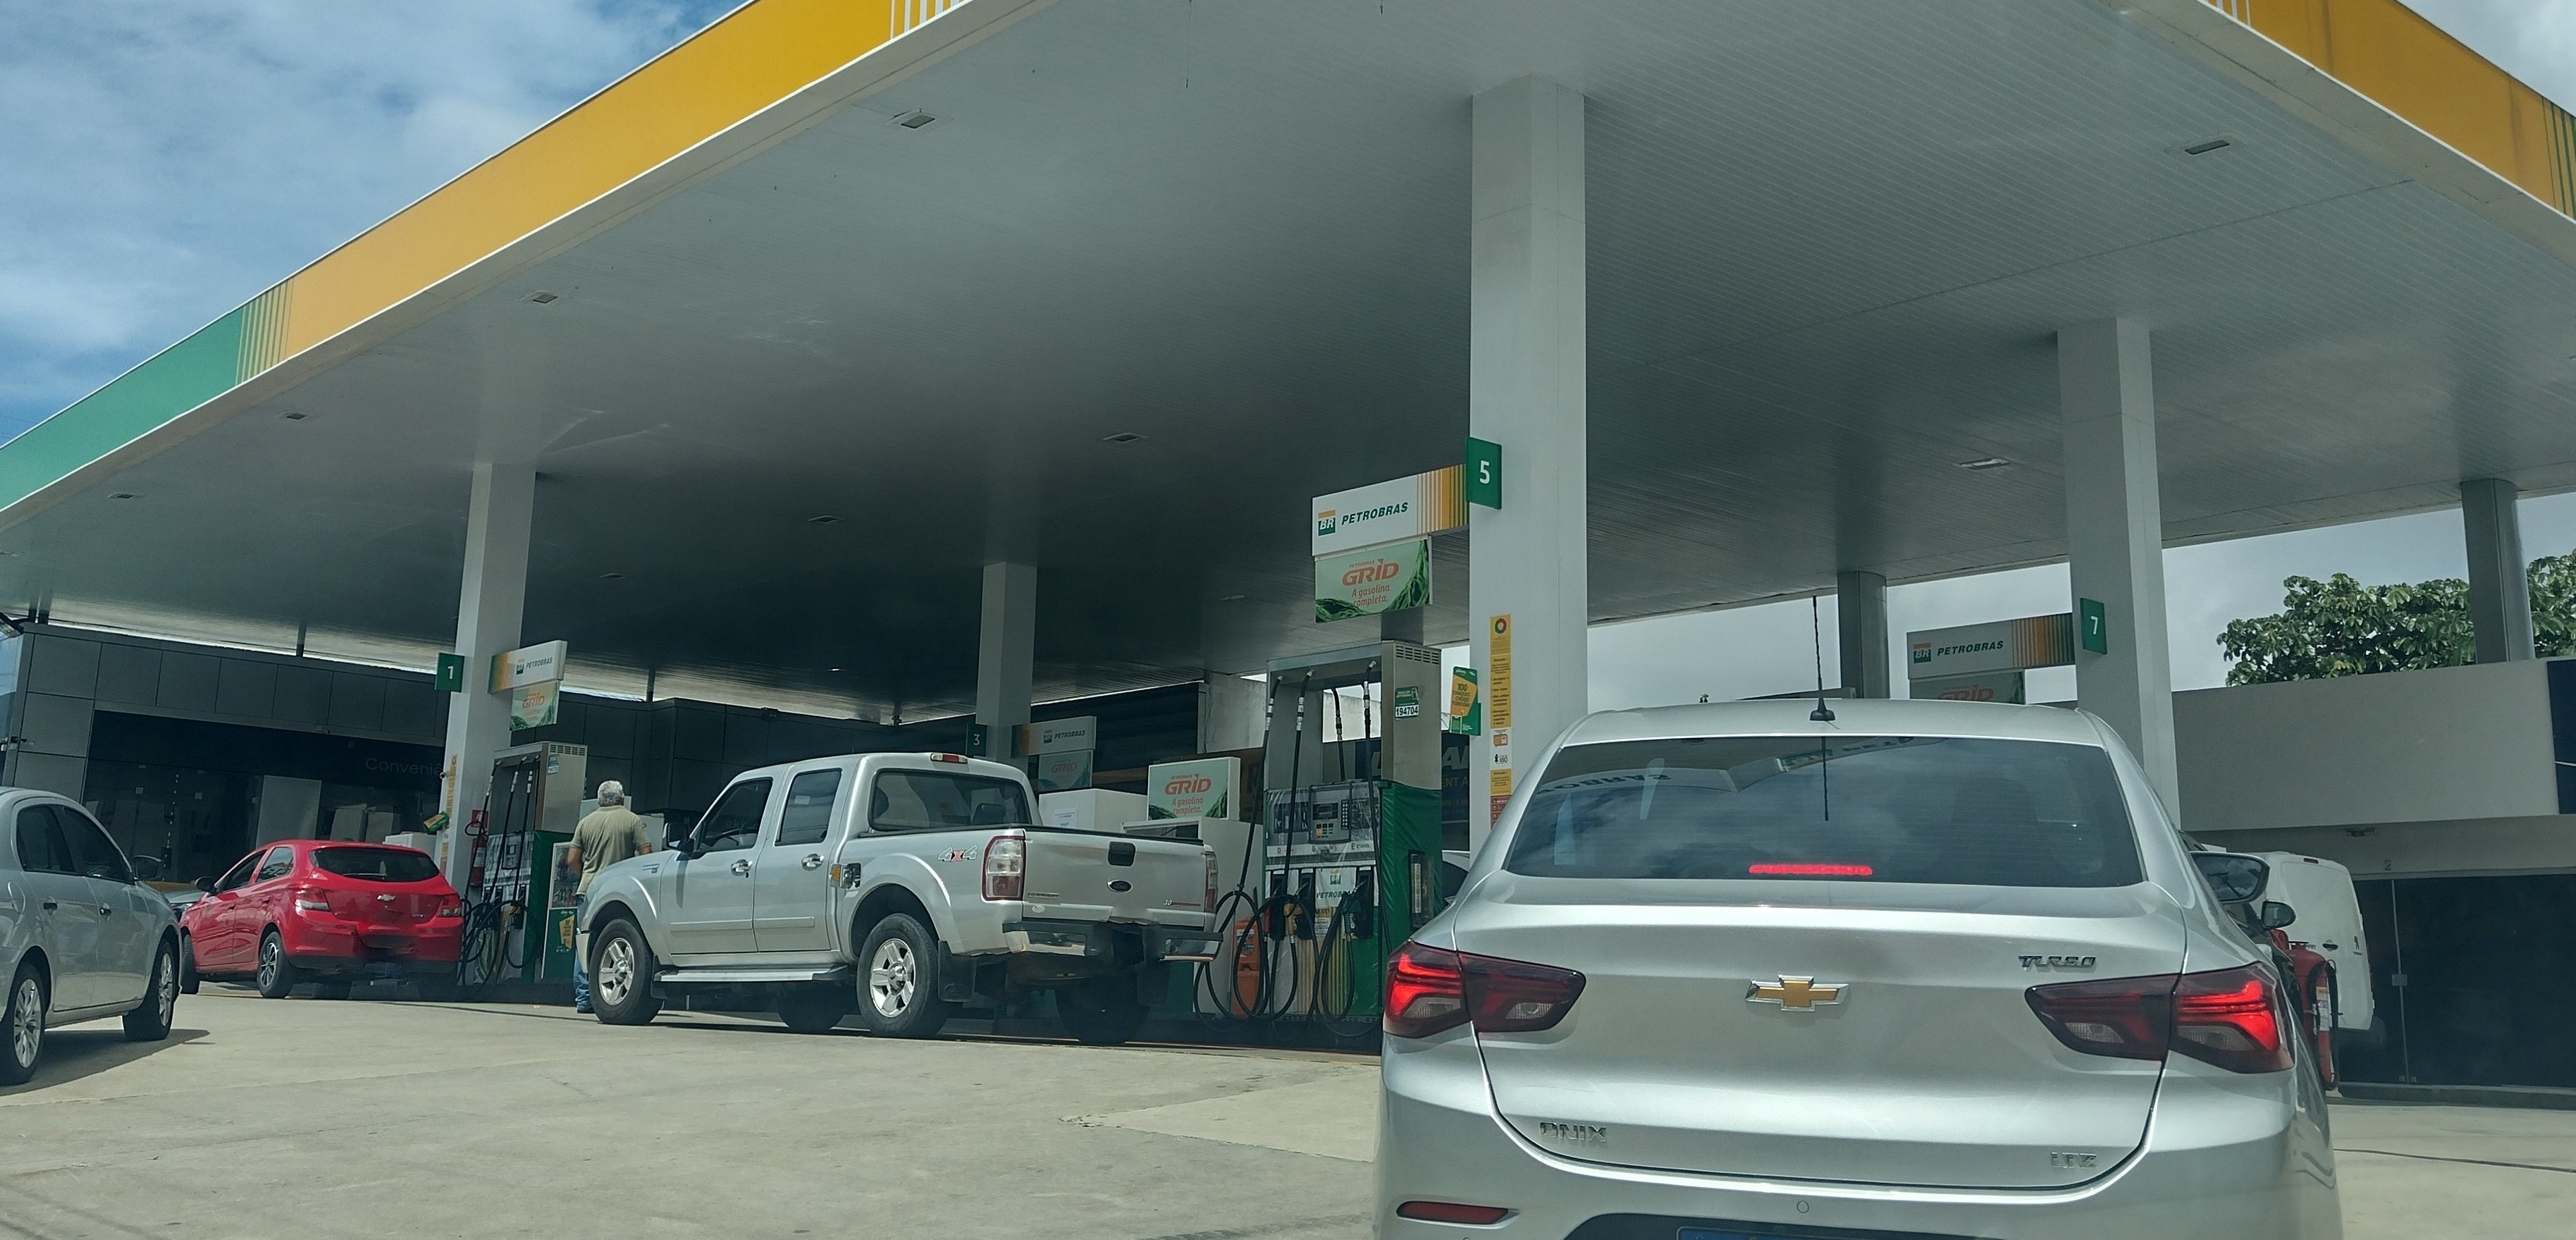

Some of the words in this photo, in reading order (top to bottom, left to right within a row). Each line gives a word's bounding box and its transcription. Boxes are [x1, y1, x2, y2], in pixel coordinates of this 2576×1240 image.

[1479, 460, 1491, 484] 5
[1319, 518, 1335, 530] BR
[1341, 501, 1409, 526] PETROBRAS
[1341, 558, 1400, 587] GRID
[1351, 588, 1357, 598] A
[1357, 584, 1391, 599] gasolina
[1353, 595, 1388, 608] completa.
[2090, 615, 2099, 635] 7
[1914, 649, 1930, 659] BR
[1937, 640, 2004, 657] PETROBRAS
[448, 665, 455, 680] 1
[1395, 706, 1419, 717] 194704
[973, 734, 980, 746] 3
[1164, 773, 1212, 795] GRID
[1172, 798, 1177, 806] A
[1177, 797, 1204, 808] gasolina
[1317, 890, 1344, 899] PETROB
[1539, 1122, 1607, 1142] ONIX
